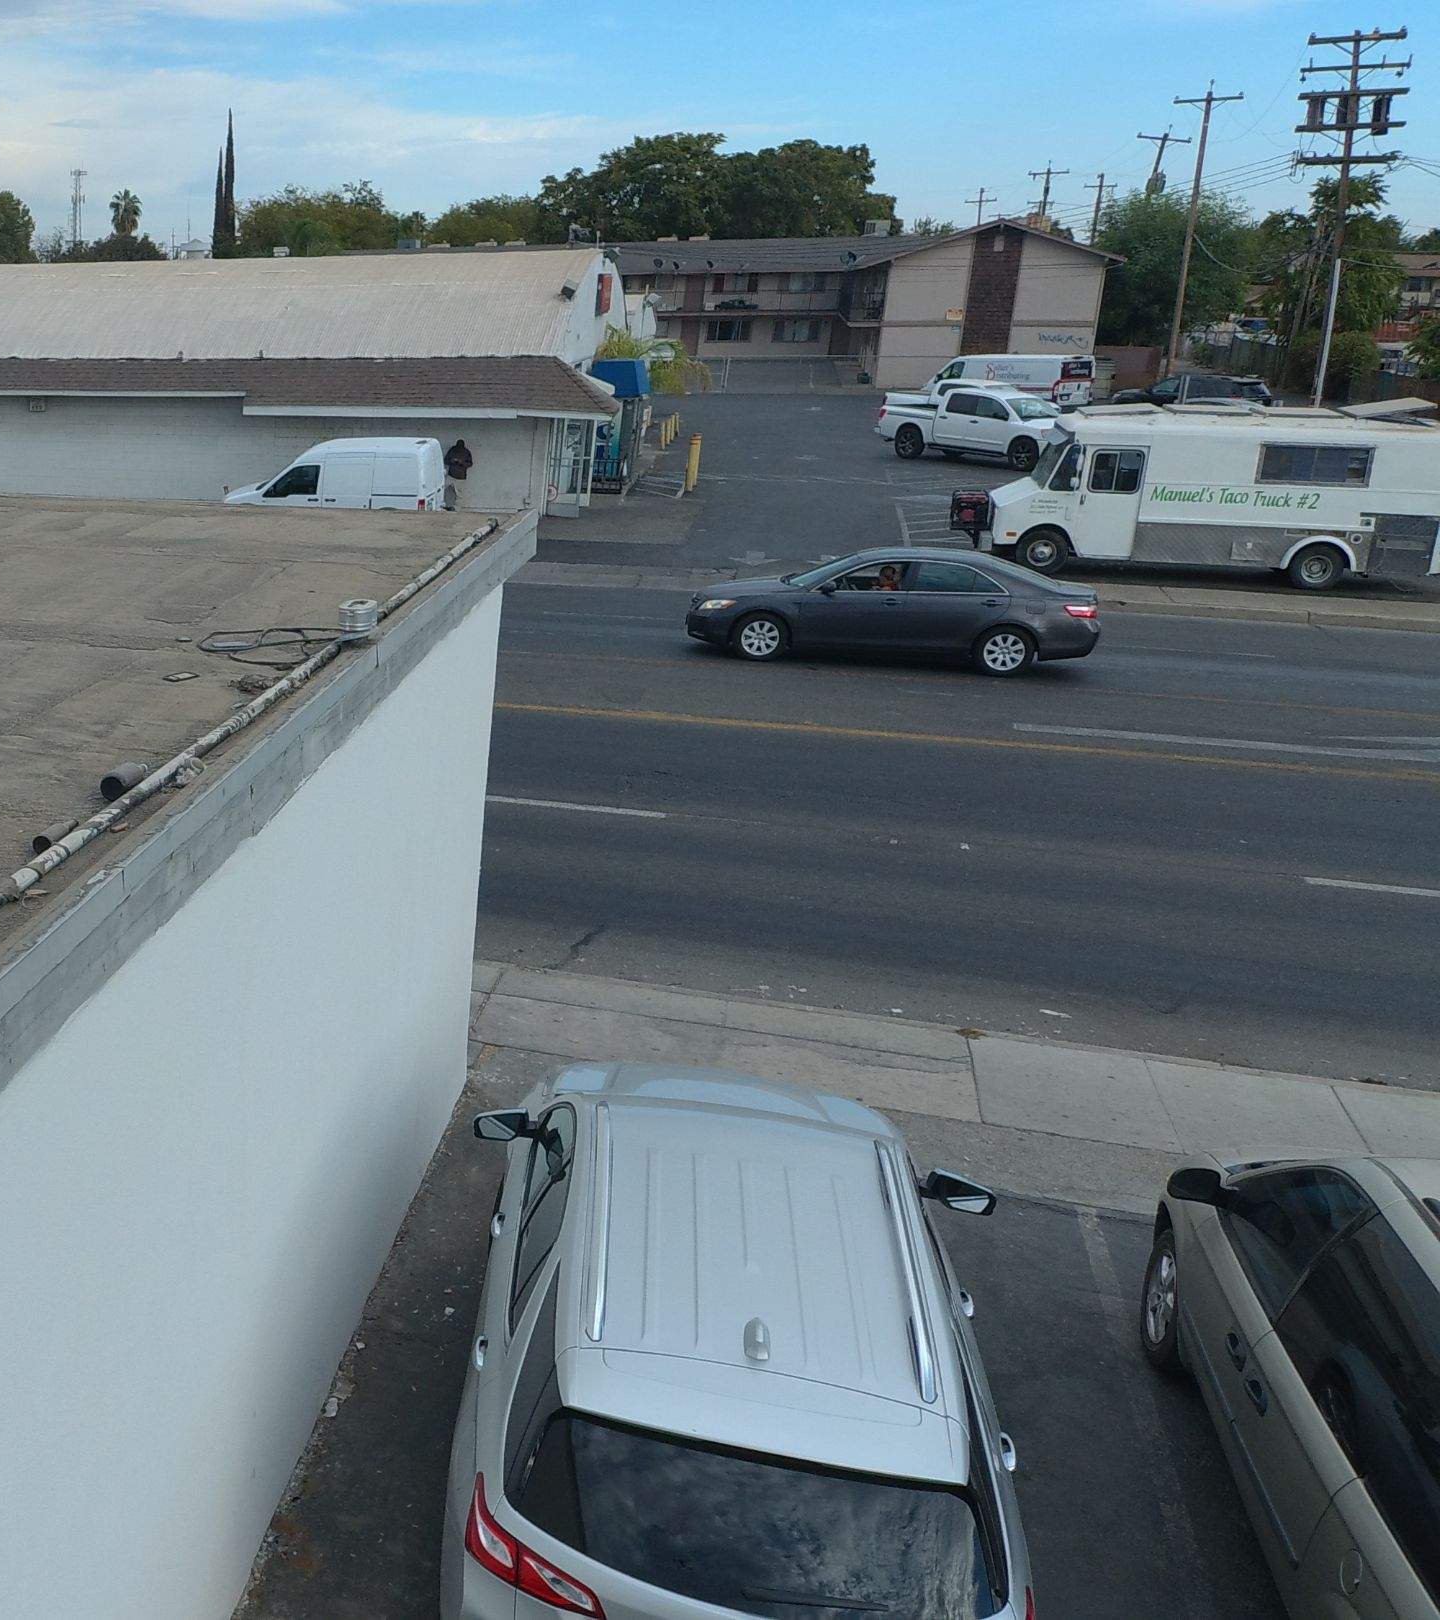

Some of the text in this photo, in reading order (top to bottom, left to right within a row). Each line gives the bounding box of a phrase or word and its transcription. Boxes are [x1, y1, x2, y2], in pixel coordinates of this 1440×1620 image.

[1150, 486, 1321, 510] Manuel's Taco Truck #2
